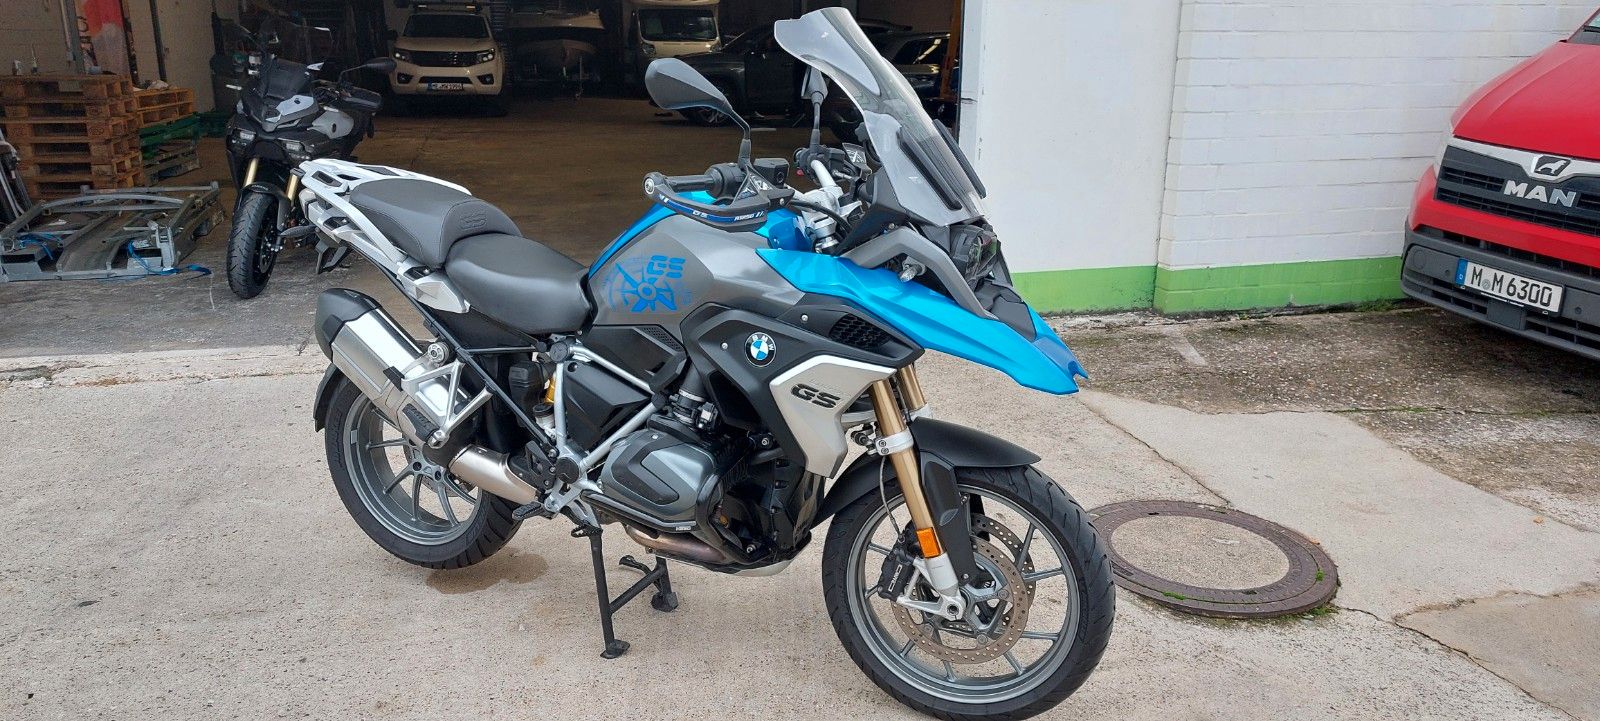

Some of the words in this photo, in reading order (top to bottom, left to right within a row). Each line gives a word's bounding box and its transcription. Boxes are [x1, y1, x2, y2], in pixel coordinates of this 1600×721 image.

[1503, 180, 1577, 208] MAN
[646, 254, 686, 279] GS
[1471, 266, 1483, 287] M
[751, 334, 775, 351] BMW
[790, 383, 841, 409] GS
